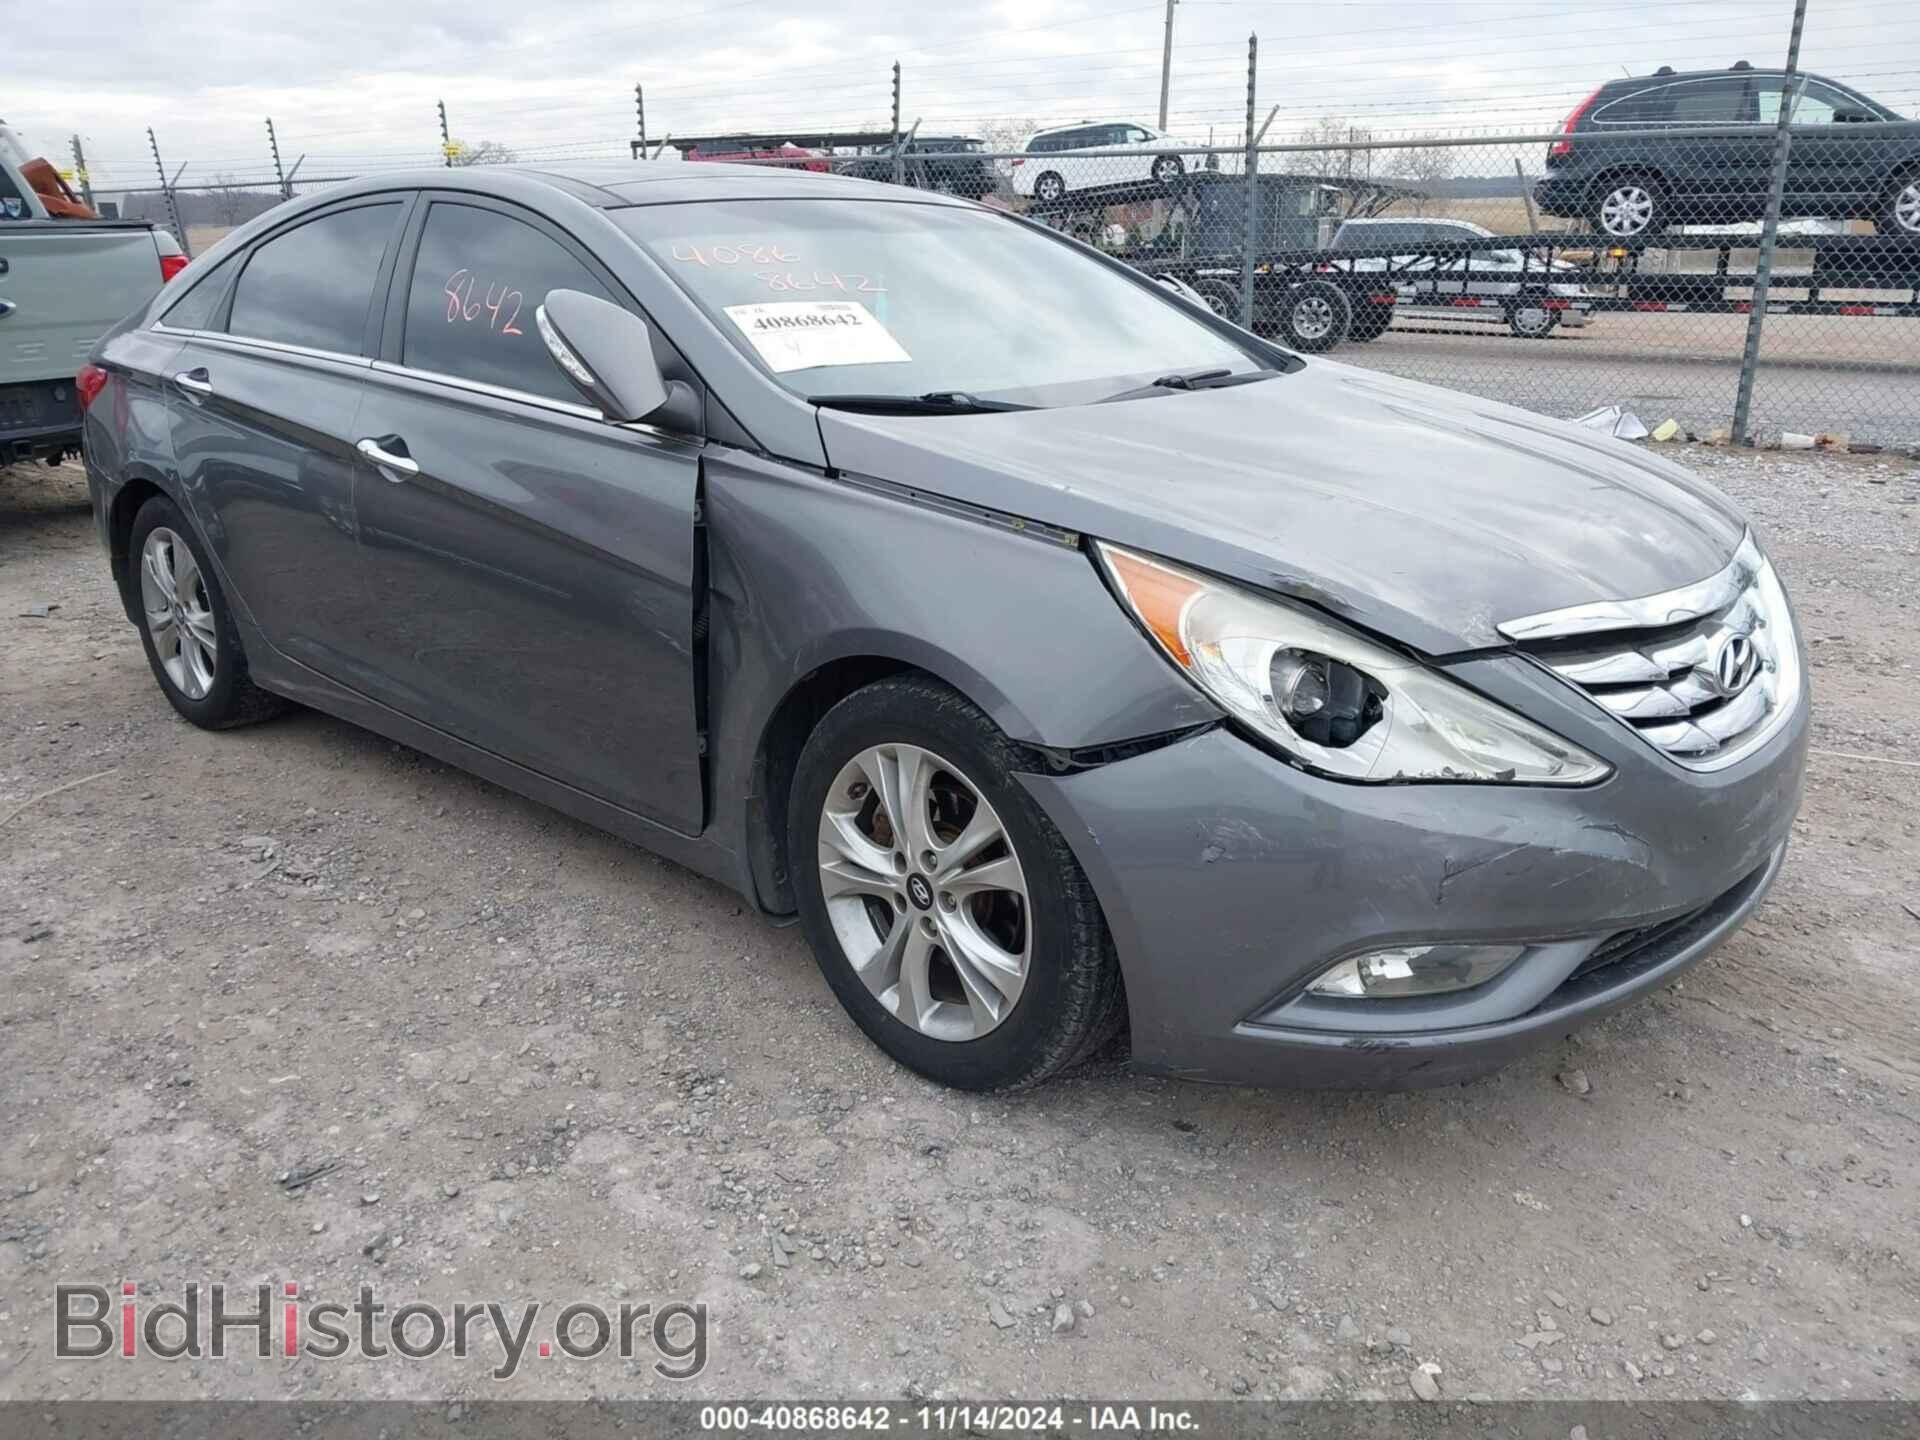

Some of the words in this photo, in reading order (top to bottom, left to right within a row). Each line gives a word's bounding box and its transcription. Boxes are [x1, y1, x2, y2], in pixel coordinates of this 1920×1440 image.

[672, 243, 801, 266] 4086
[753, 271, 889, 294] 8642
[444, 269, 524, 335] 8642
[754, 313, 863, 330] 40868642
